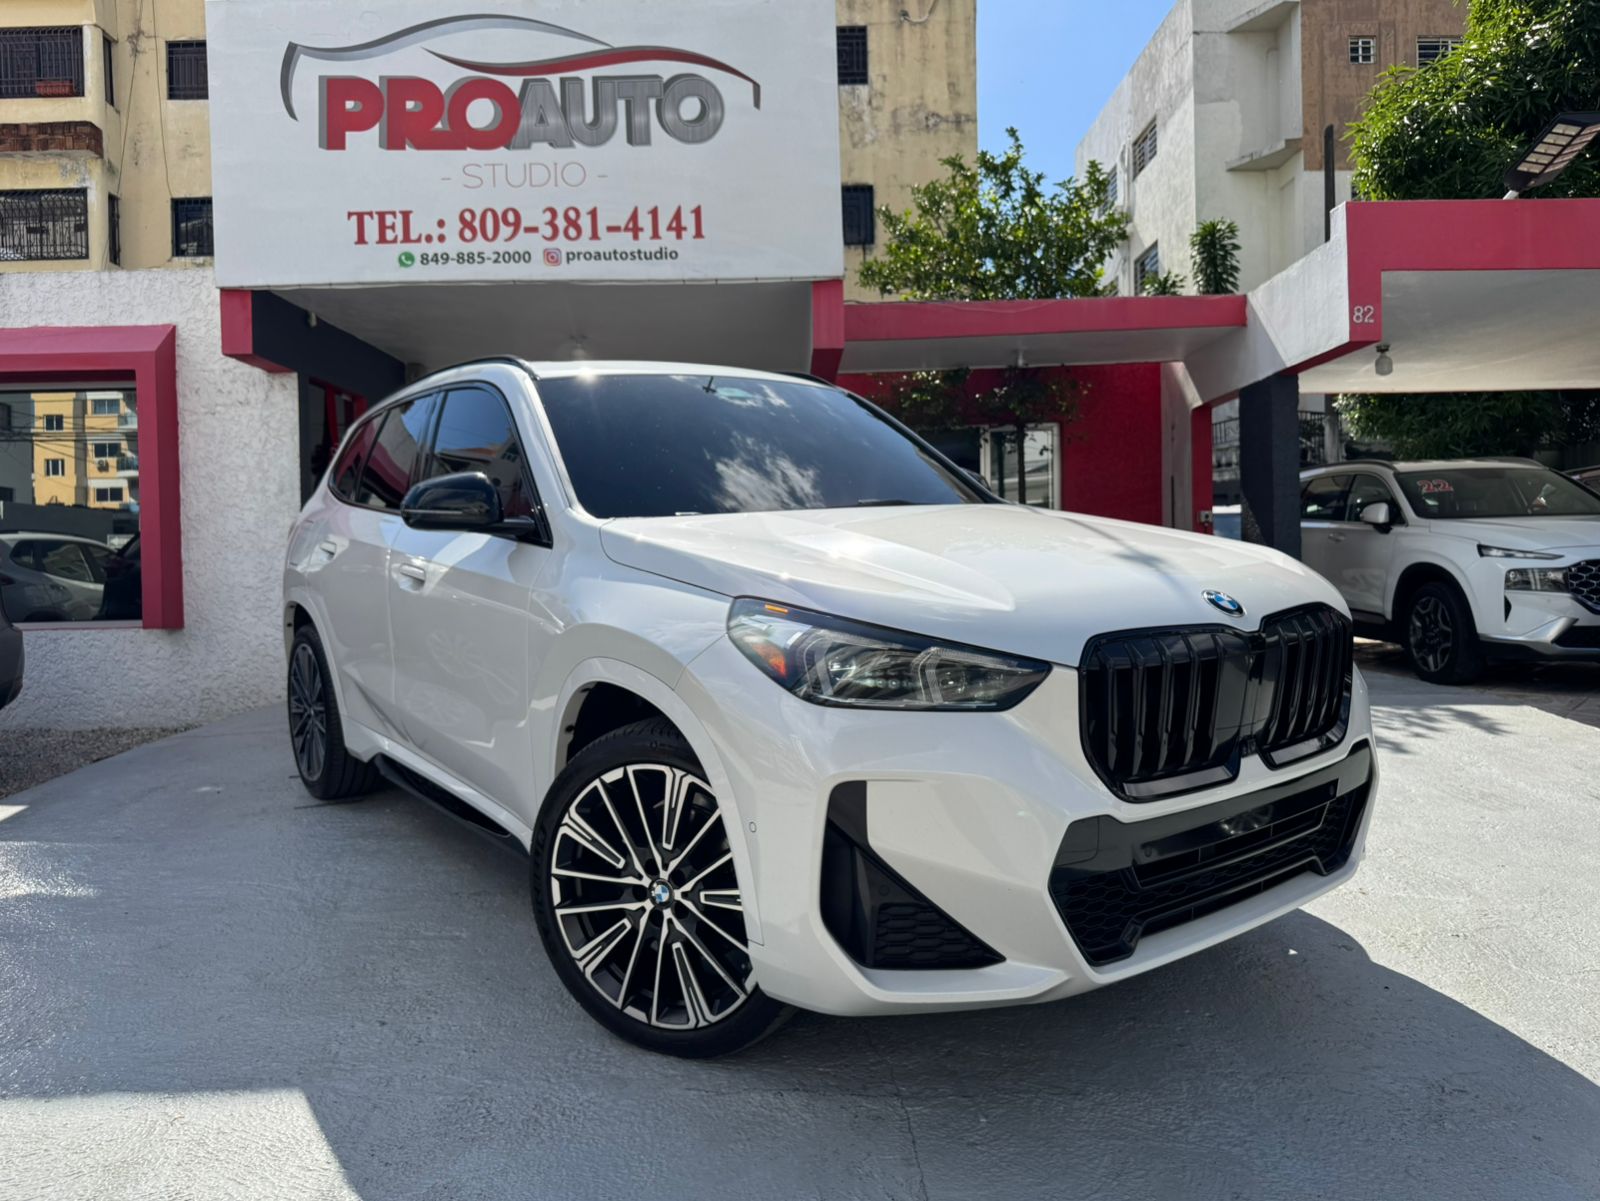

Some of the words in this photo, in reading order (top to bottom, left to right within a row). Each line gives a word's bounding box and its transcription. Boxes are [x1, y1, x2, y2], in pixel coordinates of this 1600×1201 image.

[318, 73, 725, 151] PROAUTO
[462, 161, 587, 189] STUDIO
[347, 210, 446, 245] TEL.:
[458, 205, 705, 243] 809-381-4141
[420, 251, 532, 265] 849-885-2000
[566, 247, 679, 264] proautostudio
[1353, 305, 1375, 323] 82
